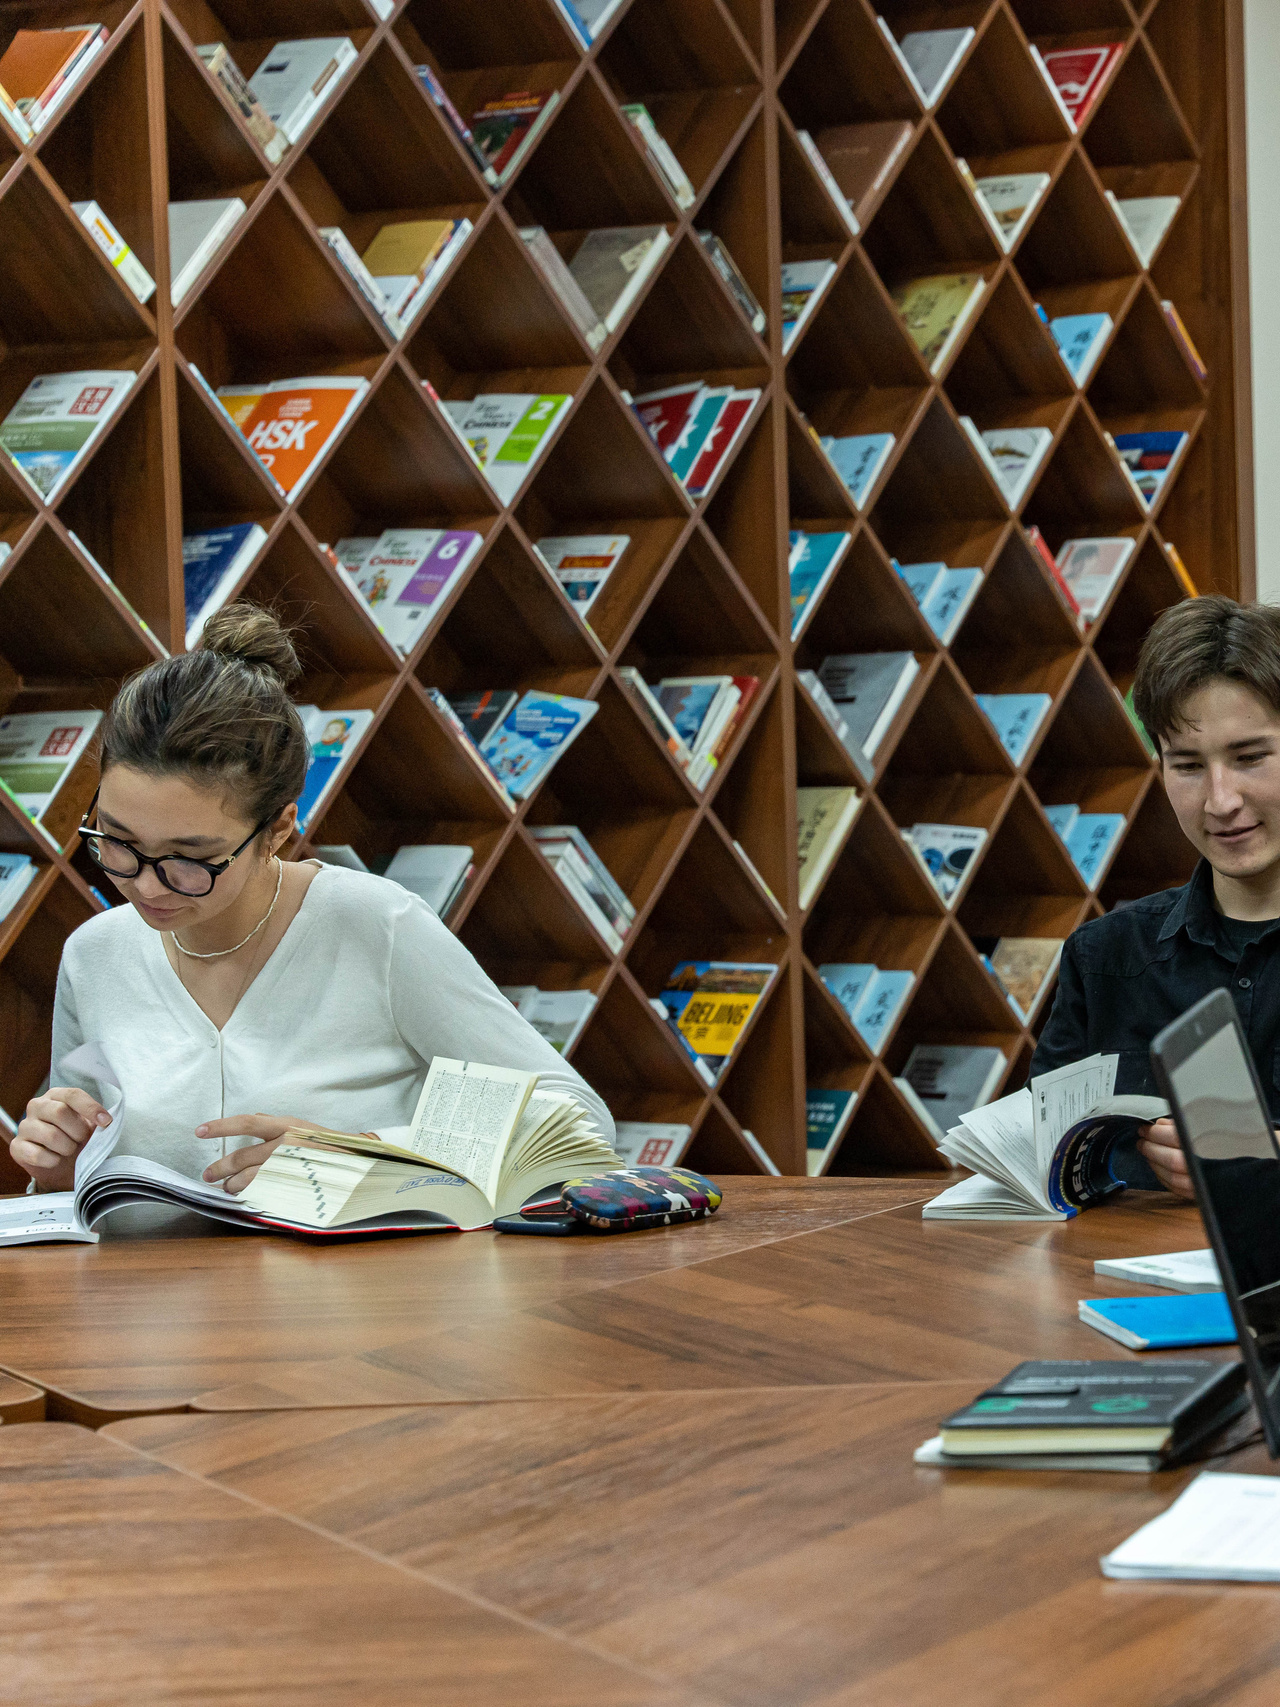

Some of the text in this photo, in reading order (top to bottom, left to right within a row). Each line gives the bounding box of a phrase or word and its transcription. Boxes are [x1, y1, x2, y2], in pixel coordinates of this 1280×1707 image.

[528, 400, 556, 420] 2
[248, 420, 319, 450] HSK
[437, 539, 461, 560] 6
[684, 1001, 750, 1026] BEIJING
[1072, 1125, 1105, 1201] IELTS
